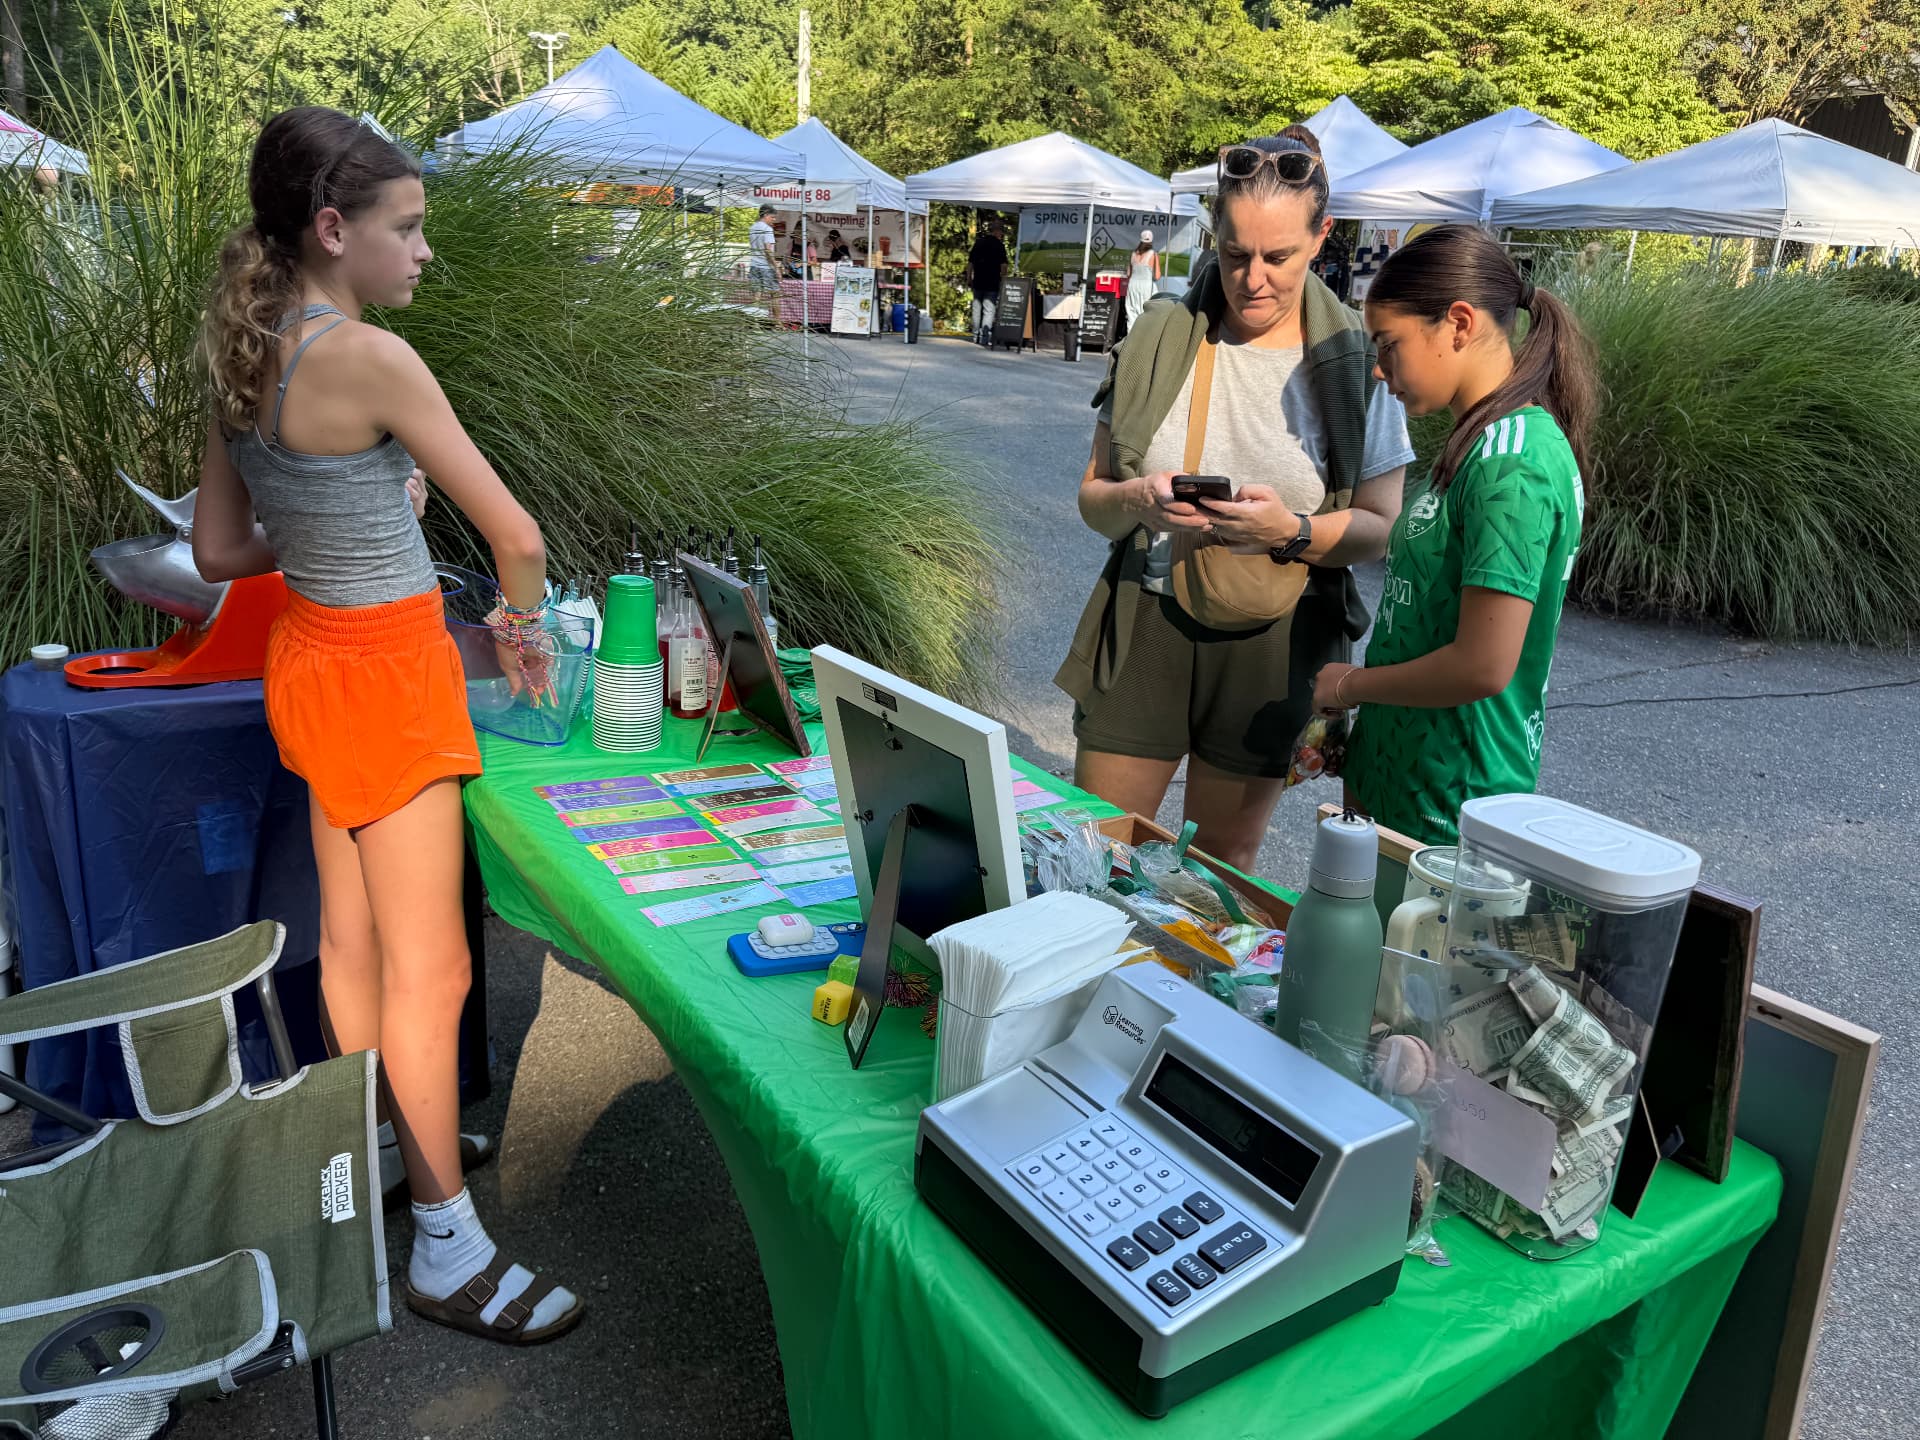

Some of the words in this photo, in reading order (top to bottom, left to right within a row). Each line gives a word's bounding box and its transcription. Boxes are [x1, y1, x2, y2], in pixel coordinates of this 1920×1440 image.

[815, 188, 831, 202] 88
[815, 212, 865, 228] Dumpling
[1035, 212, 1079, 225] SPRING
[1083, 213, 1137, 226] HOLLOW
[1141, 214, 1178, 227] FARM
[1118, 1012, 1144, 1037] Learning
[1114, 1020, 1144, 1045] Resources
[1101, 1124, 1116, 1134] 7
[1079, 1139, 1091, 1148] 4
[1055, 1152, 1067, 1161] 1
[1128, 1146, 1142, 1156] 8
[1028, 1165, 1042, 1175] 0
[1104, 1160, 1118, 1170] 5
[1079, 1174, 1093, 1184] 2
[1157, 1169, 1170, 1179] 9
[320, 1166, 331, 1219] KICKBACK
[334, 1161, 350, 1212] ROCKER
[1133, 1183, 1146, 1193] 6
[1107, 1198, 1121, 1208] 3
[1212, 1231, 1252, 1257] OPEN
[1180, 1257, 1208, 1280] ON/C
[1156, 1276, 1180, 1293] OFF
